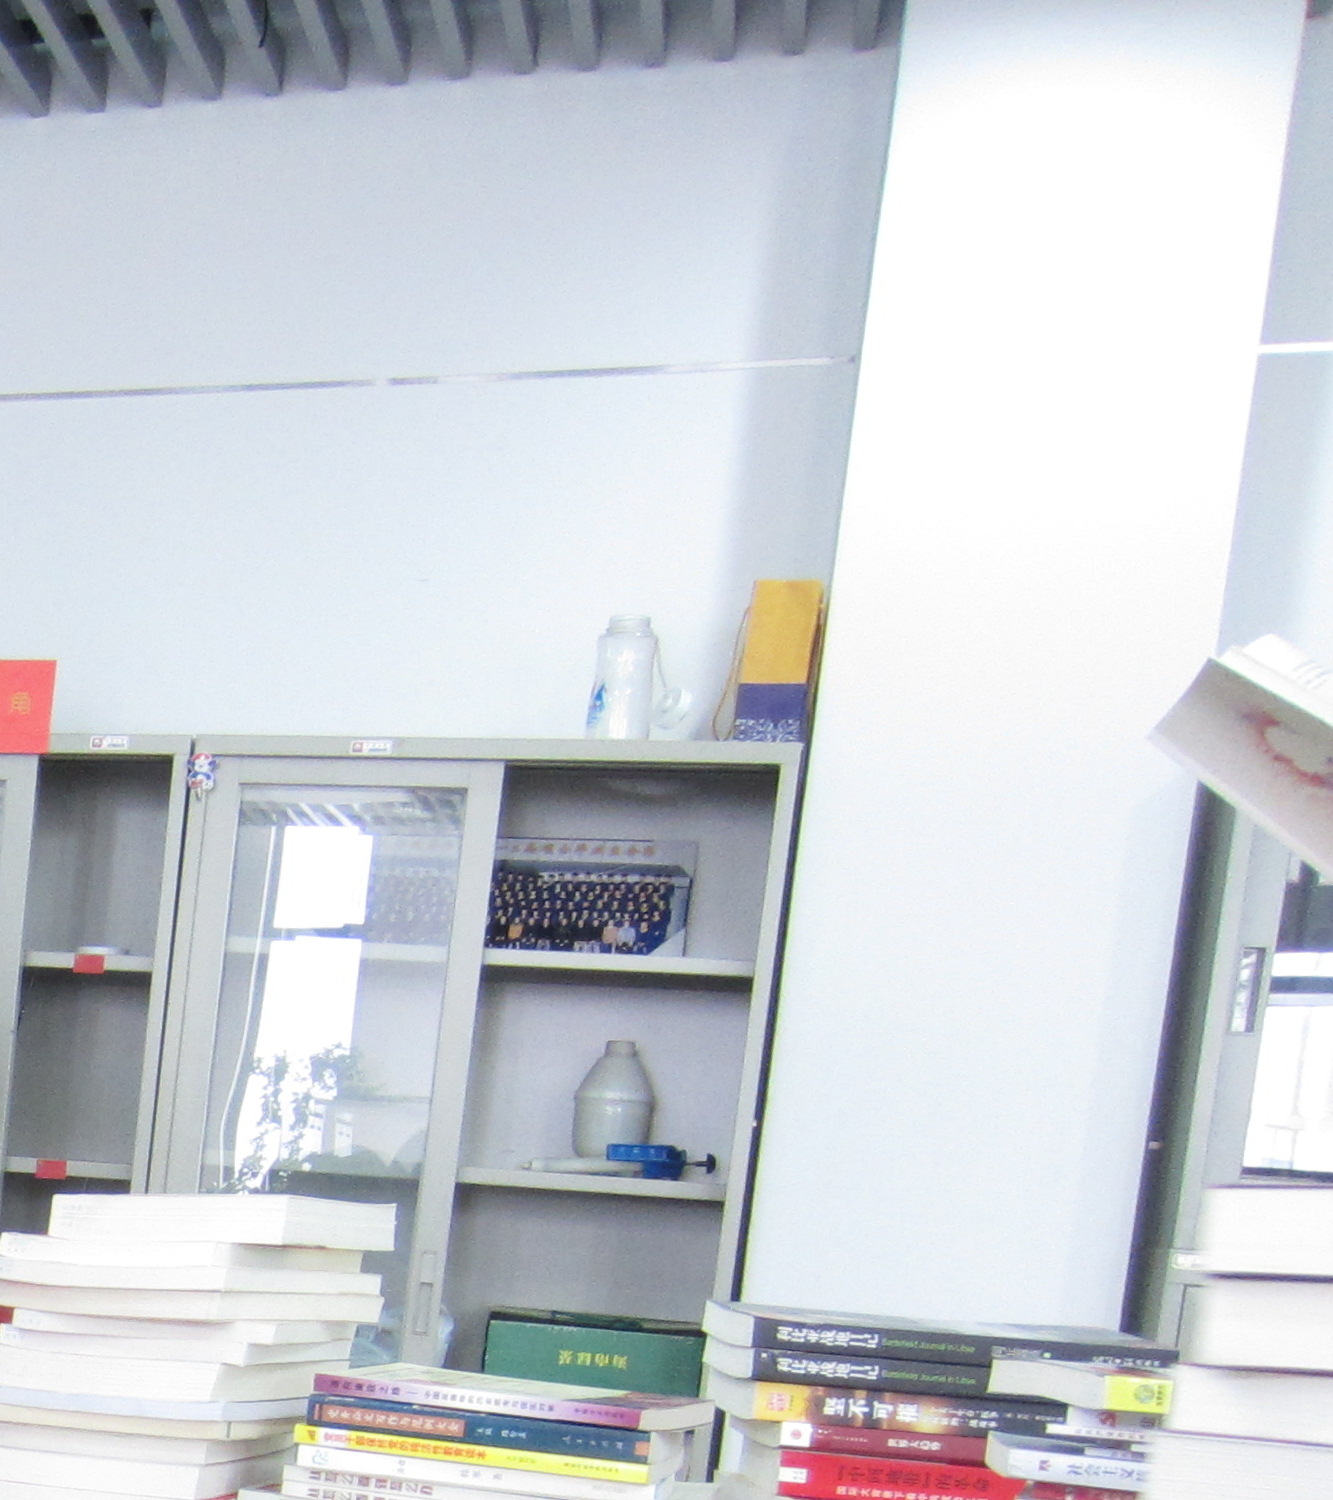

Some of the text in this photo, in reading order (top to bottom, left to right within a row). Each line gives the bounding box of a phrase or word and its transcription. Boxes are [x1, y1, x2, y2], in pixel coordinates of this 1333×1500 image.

[776, 1326, 879, 1349] 利比亚战地日记
[776, 1358, 879, 1381] 利比亚战地日记
[823, 1396, 920, 1423] 坚不可摧
